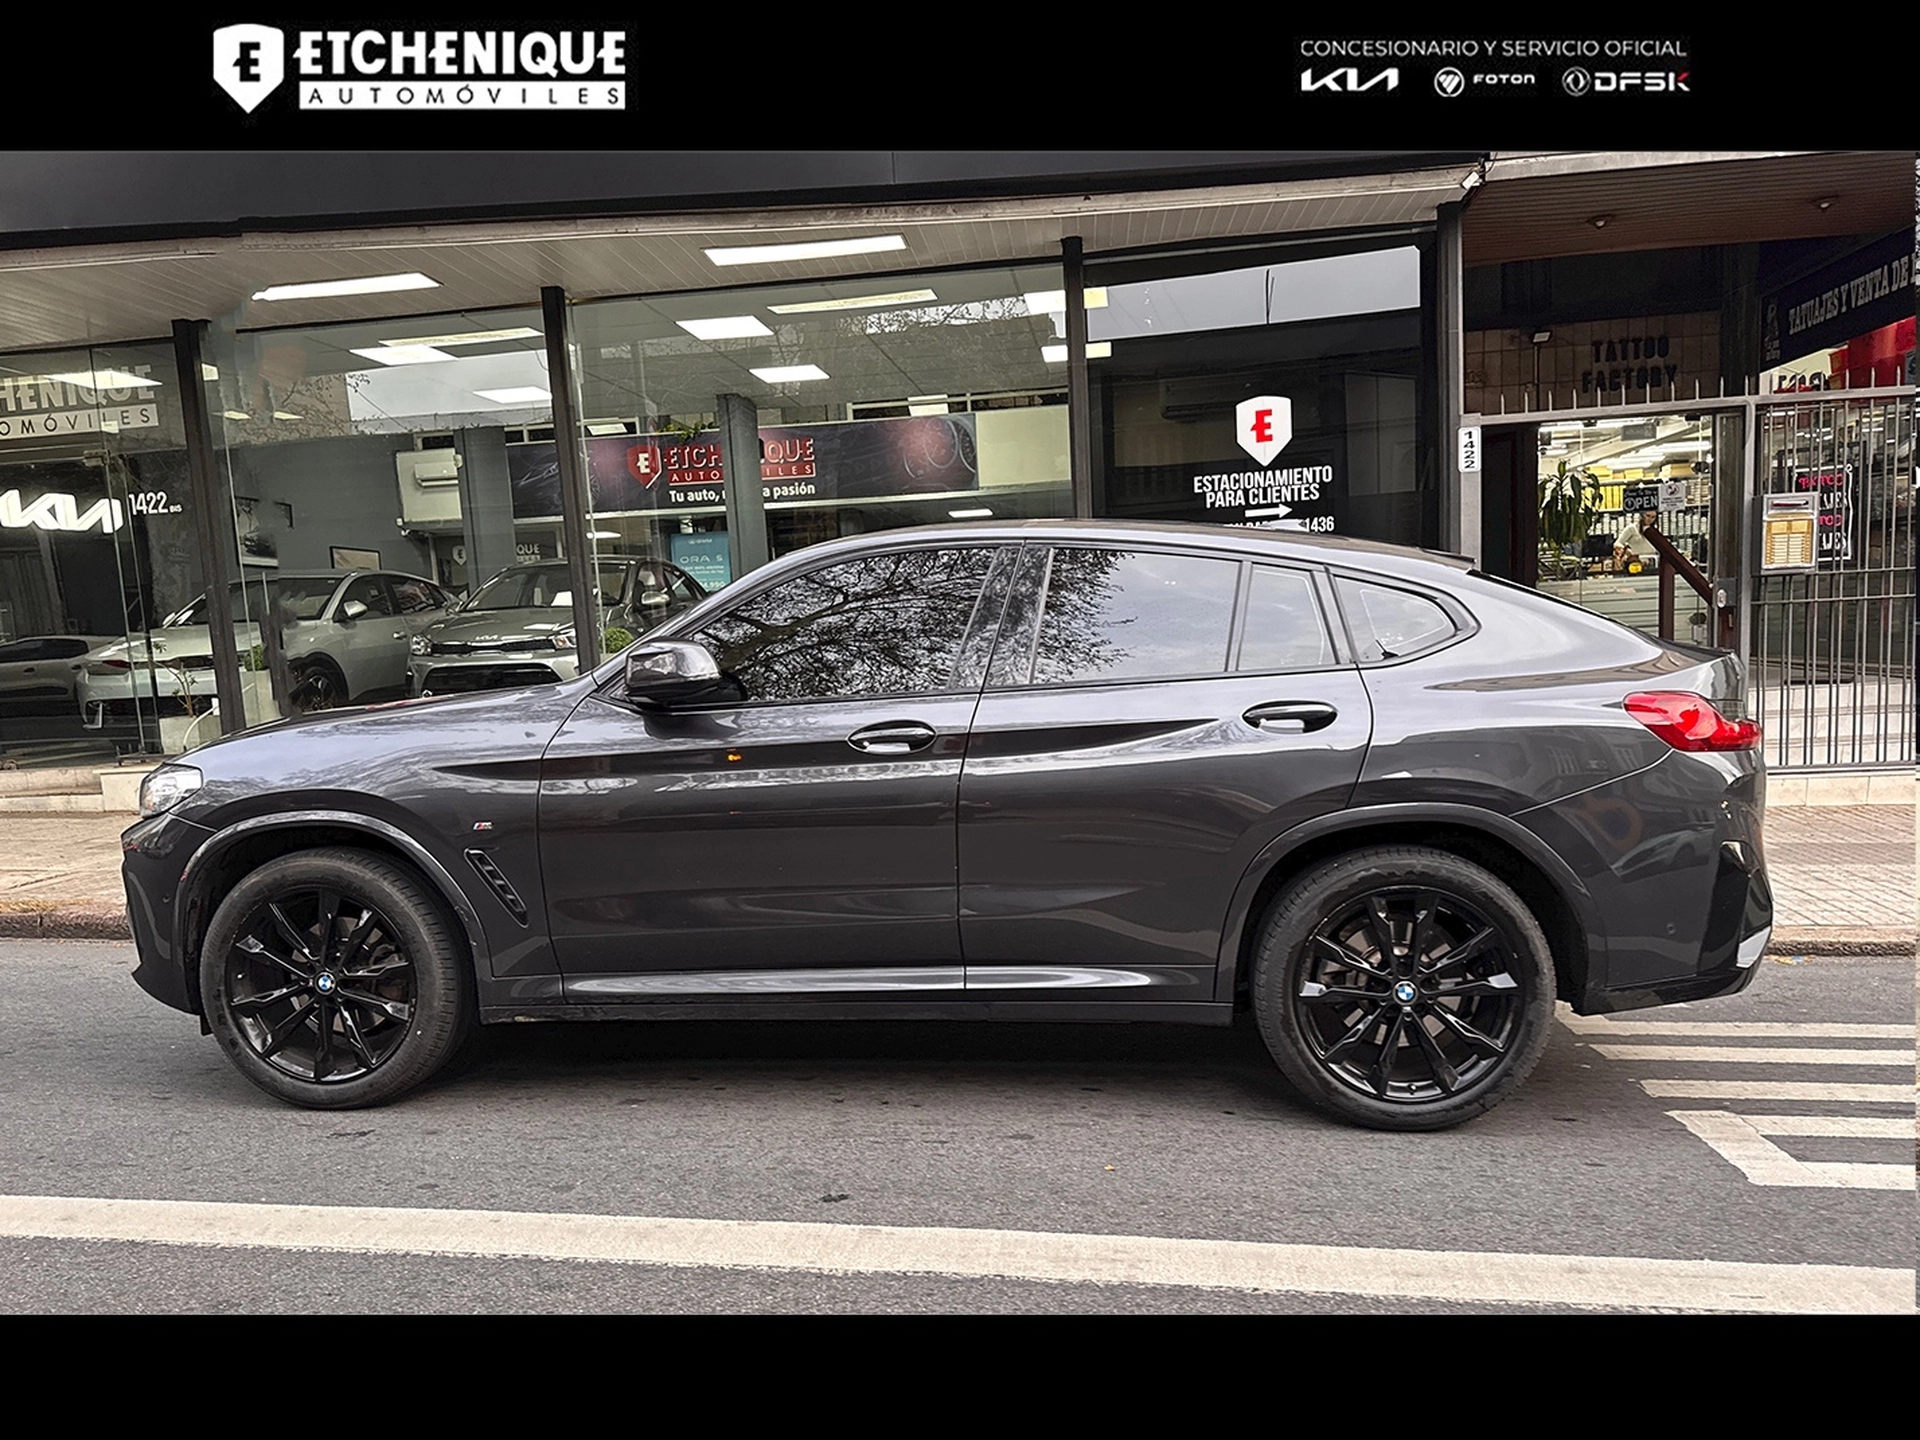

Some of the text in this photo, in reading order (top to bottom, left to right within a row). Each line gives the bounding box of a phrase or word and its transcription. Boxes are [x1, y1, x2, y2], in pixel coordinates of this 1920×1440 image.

[1789, 287, 1839, 335] TATUAJES
[1841, 283, 1850, 313] Y
[1850, 265, 1890, 308] VENTA
[1892, 255, 1909, 292] DE
[1592, 335, 1669, 363] TATTOO
[1582, 364, 1678, 393] FACTORY
[1463, 430, 1476, 470] 1422
[669, 490, 684, 503] Tu
[687, 489, 720, 503] auto,
[772, 481, 816, 500] pasión
[1193, 464, 1333, 494] ESTACIONAMIENTO
[129, 491, 169, 516] 1422
[1206, 483, 1320, 509] PARA CLIENTES
[1623, 495, 1658, 512] OPEN
[1305, 515, 1335, 533] 1436
[680, 554, 711, 564] ORA
